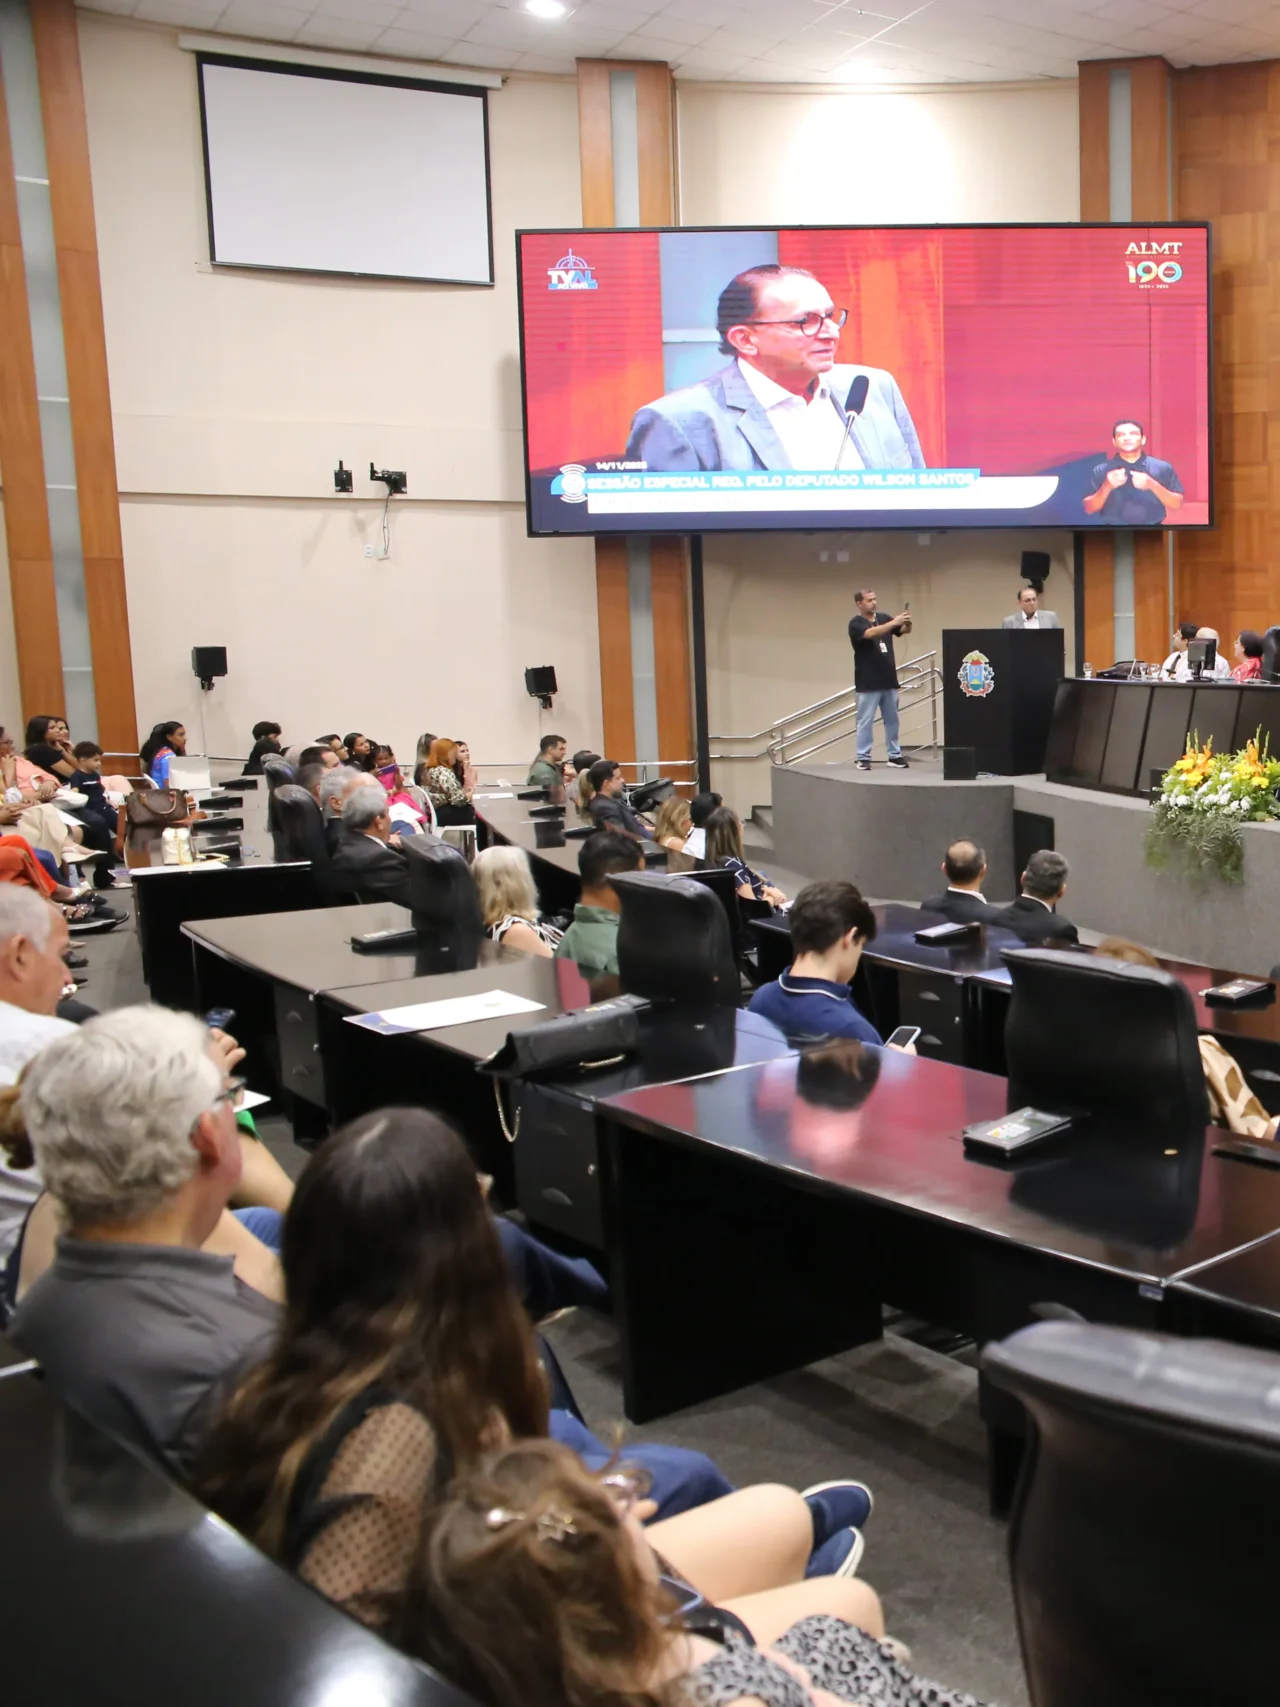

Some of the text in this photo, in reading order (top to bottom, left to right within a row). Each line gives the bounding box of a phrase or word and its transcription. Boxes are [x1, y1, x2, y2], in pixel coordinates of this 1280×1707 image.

[1125, 242, 1182, 254] ALMT
[1125, 261, 1183, 283] 190
[643, 476, 710, 489] ESPECIAL
[746, 475, 783, 488] PELO
[785, 474, 860, 487] DEPUTADO
[862, 473, 916, 486] WILSON
[918, 472, 976, 486] SANTOS
